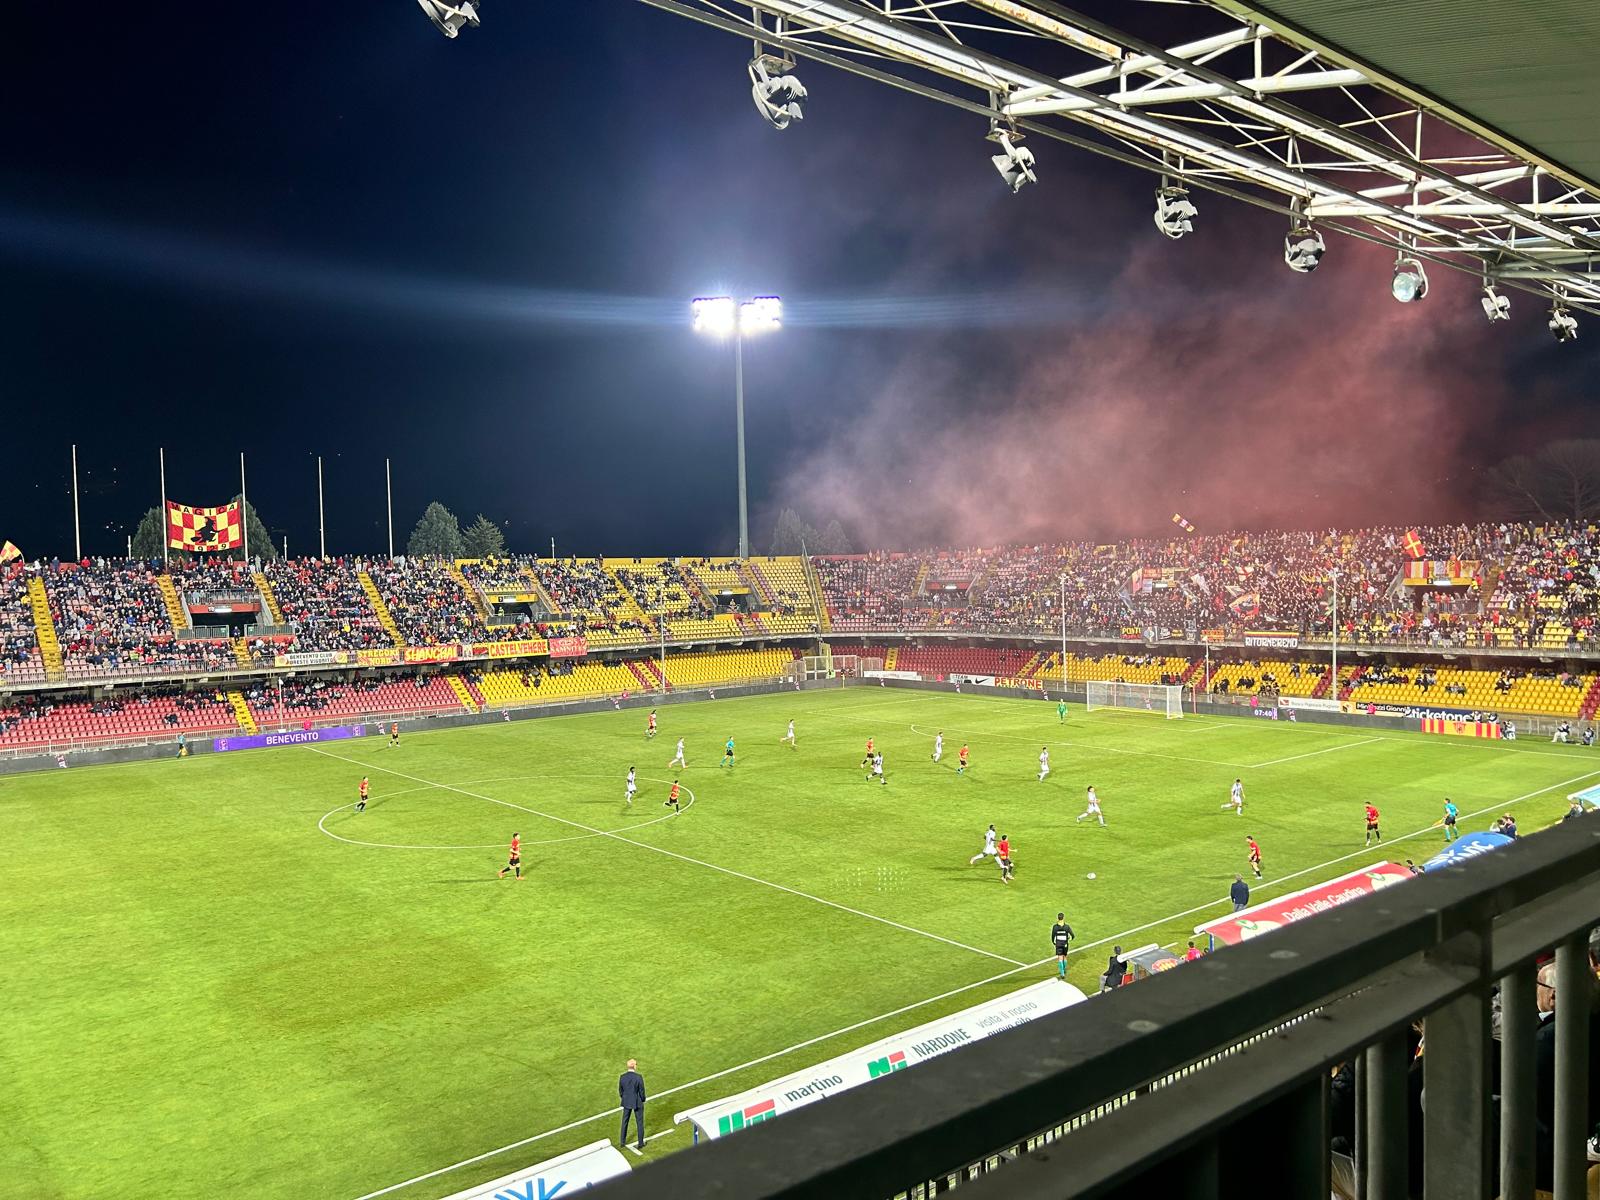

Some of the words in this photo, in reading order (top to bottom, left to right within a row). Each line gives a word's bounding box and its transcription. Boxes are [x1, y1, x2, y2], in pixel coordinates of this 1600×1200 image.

[171, 502, 235, 516] MAGICA
[186, 543, 227, 552] 1929
[405, 646, 457, 661] SHANGHAI
[994, 677, 1043, 690] PETRONE
[266, 732, 319, 745] BENEVENTO
[1281, 907, 1312, 922] Dalla
[1304, 899, 1331, 914] Valle
[975, 1015, 1003, 1029] visita
[1007, 1001, 1038, 1018] nostro
[911, 1028, 972, 1058] NARDONE
[784, 1074, 844, 1102] martino
